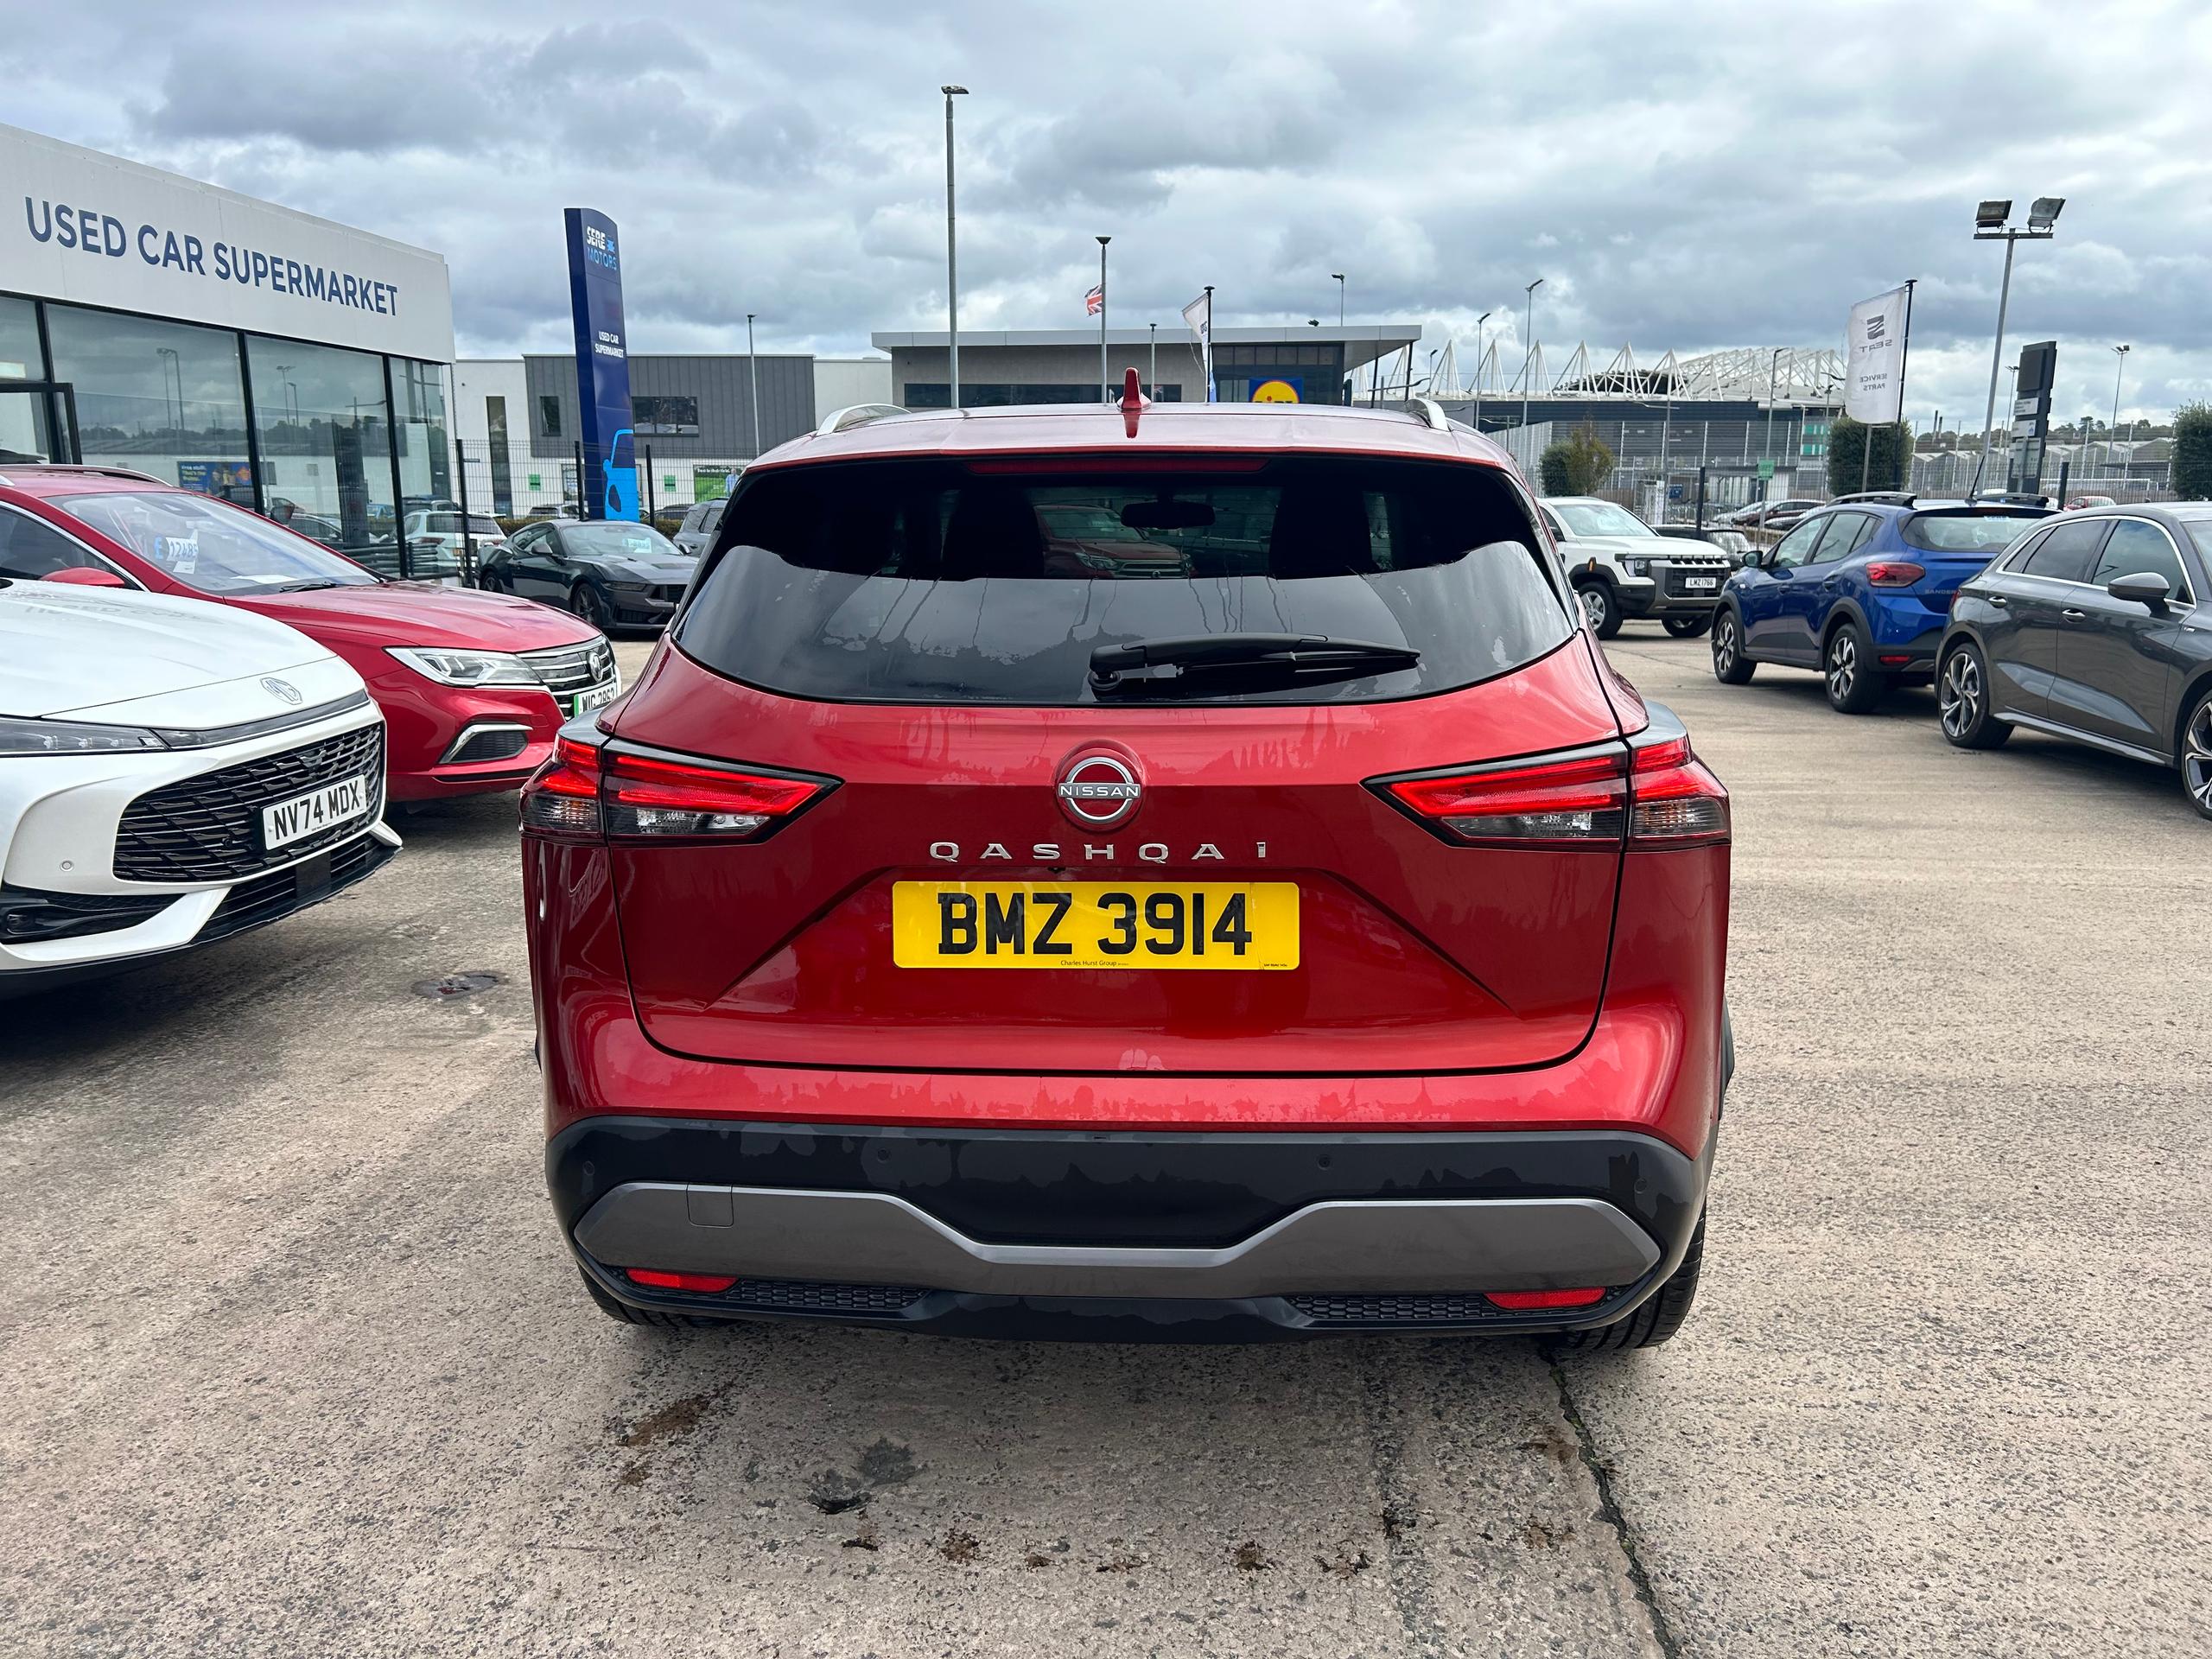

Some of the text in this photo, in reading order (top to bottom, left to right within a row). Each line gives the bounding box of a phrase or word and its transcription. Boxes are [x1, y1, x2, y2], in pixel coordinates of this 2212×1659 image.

[587, 226, 607, 251] SERE
[25, 196, 398, 317] USED CAR SUPERMARKET
[588, 246, 617, 270] MOTORS
[598, 331, 620, 344] USED CAR
[594, 343, 624, 359] SUPERMARKET
[1060, 785, 1140, 797] NISSAN
[273, 779, 361, 841] NV74 MDX
[938, 892, 1253, 955] BMZ 3914
